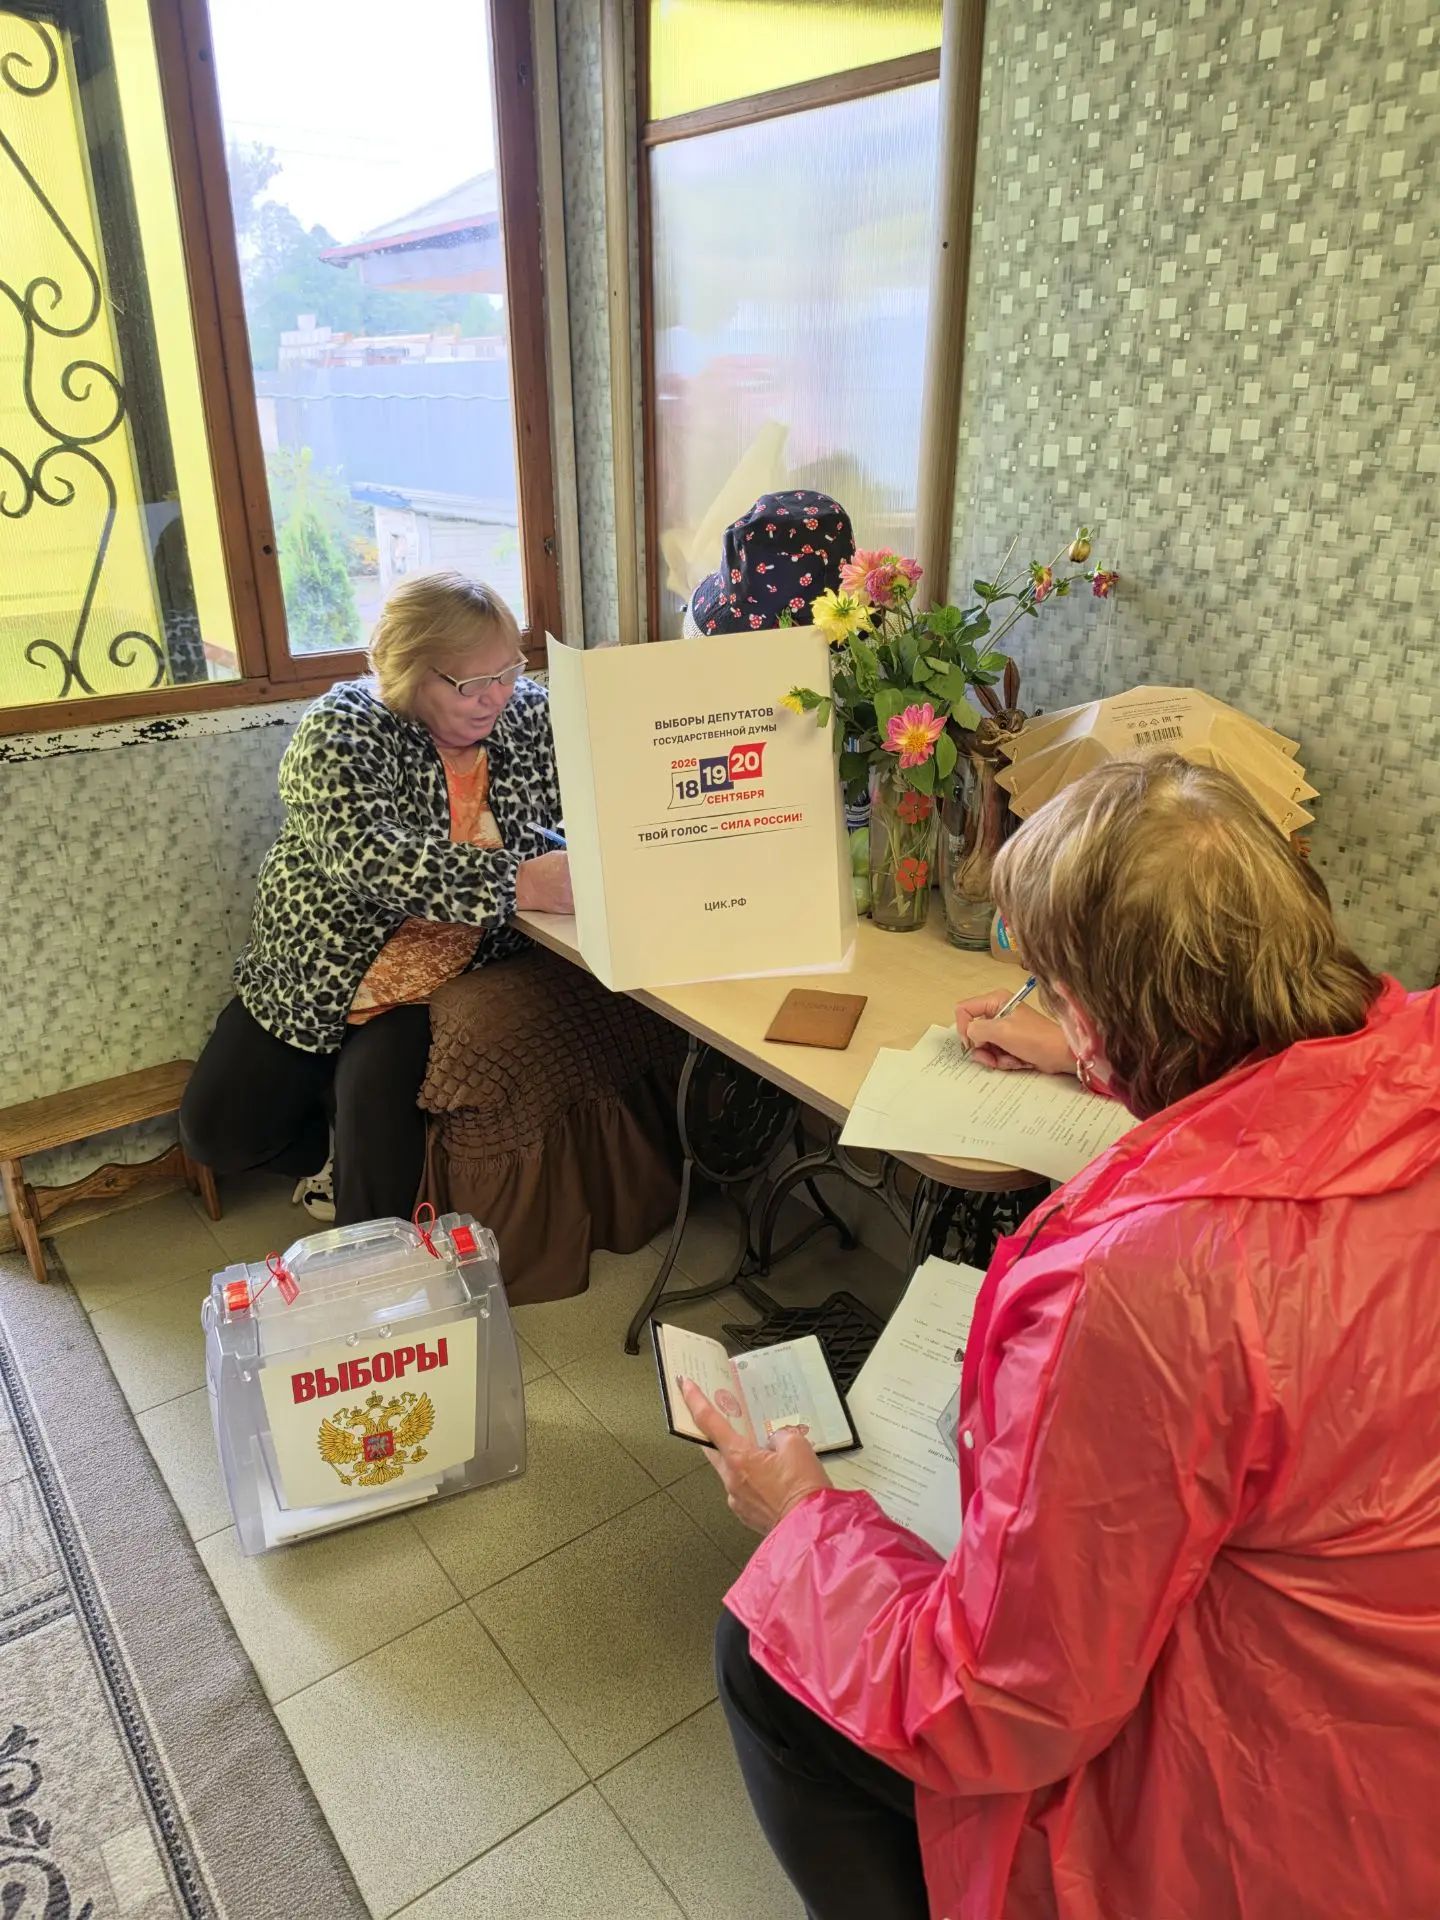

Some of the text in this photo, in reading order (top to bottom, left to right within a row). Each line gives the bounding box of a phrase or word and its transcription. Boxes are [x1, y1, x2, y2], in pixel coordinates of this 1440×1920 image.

[655, 707, 774, 730] ВЫБОРЫ ДЕПУТАТОВ
[653, 724, 777, 746] ГОСУДАРСТВЕННОЙ ДУМЫ
[671, 758, 697, 769] 2026
[675, 751, 759, 799] 18 19 20
[707, 789, 765, 805] СЕНТЯБРЯ
[638, 828, 668, 842] ТВОЙ
[671, 825, 708, 837] ГОЛОС
[720, 817, 751, 831] СИЛА
[754, 813, 803, 826] РОССИИ!
[704, 897, 747, 911] ЦИК.РФ
[291, 1338, 449, 1404] ВЫБОРЫ
